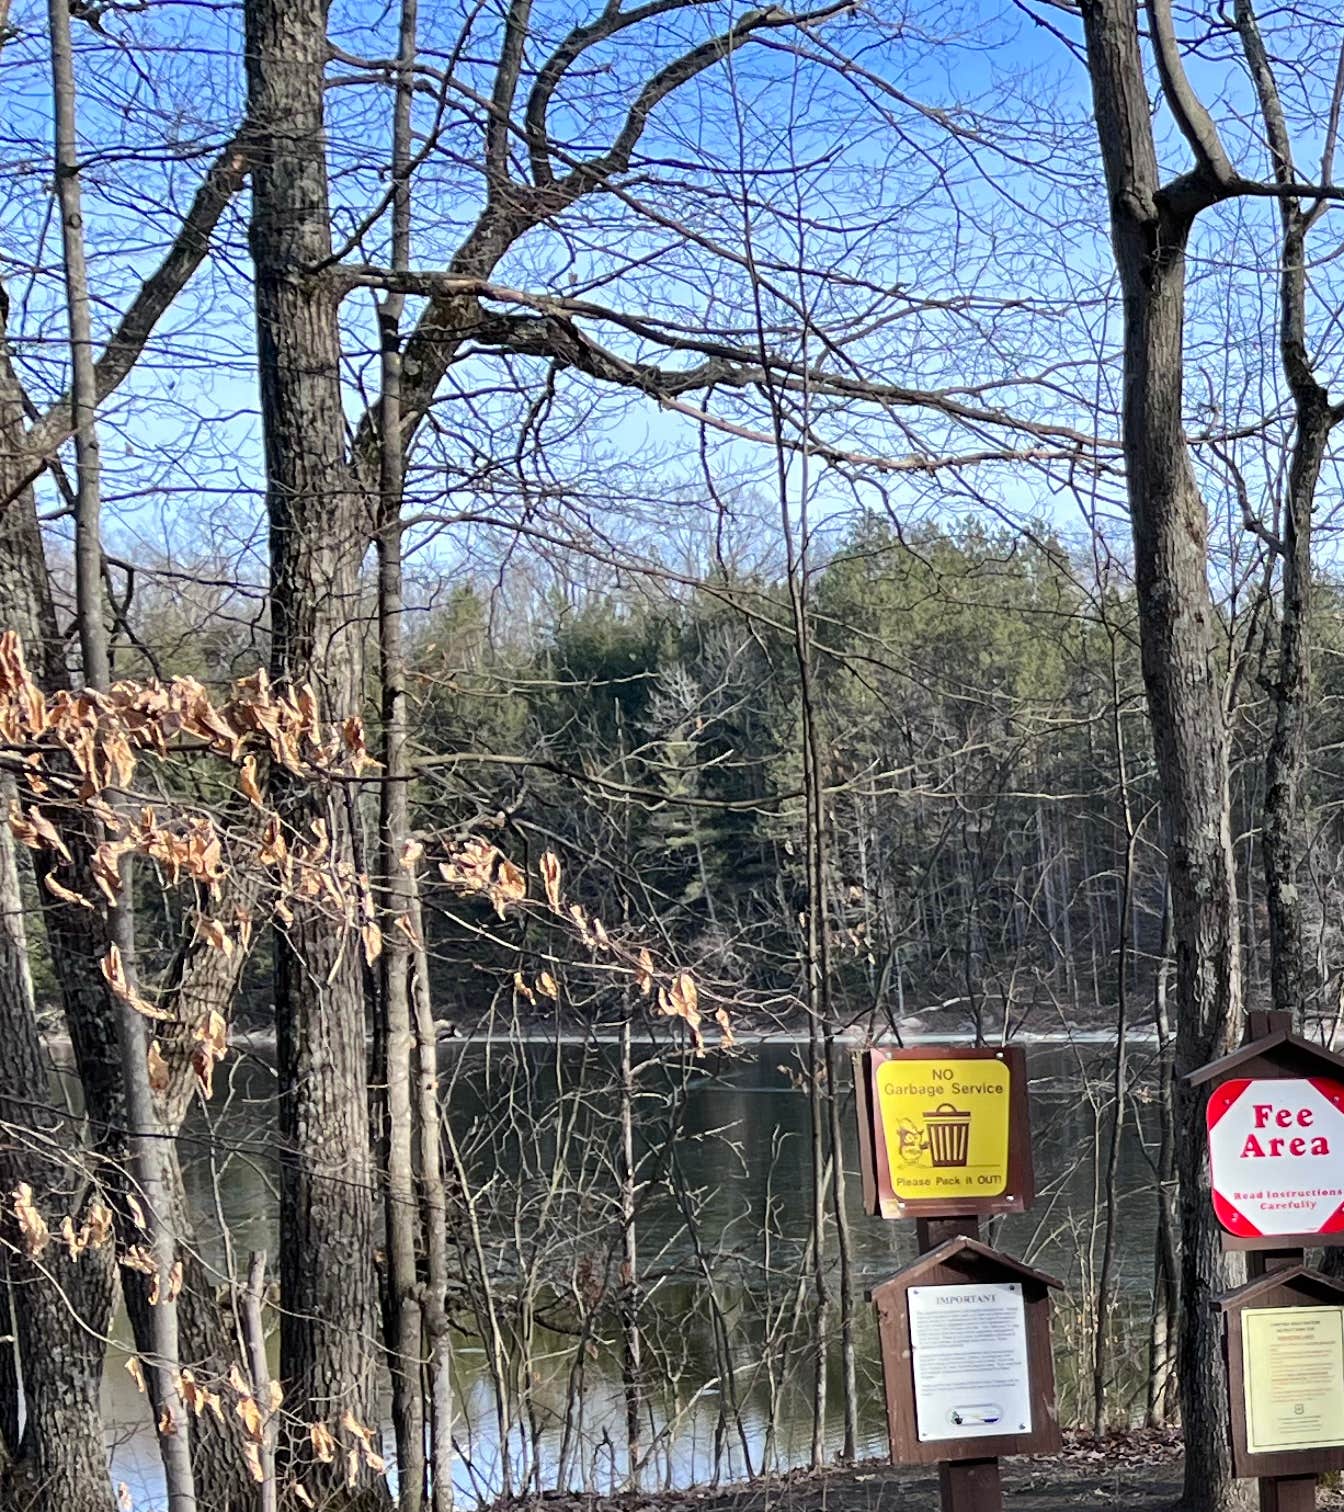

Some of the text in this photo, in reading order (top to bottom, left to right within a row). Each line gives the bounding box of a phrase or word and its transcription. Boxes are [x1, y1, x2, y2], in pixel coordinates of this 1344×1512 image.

[932, 1069, 954, 1081] NO
[884, 1082, 1004, 1097] Garbage Service
[1252, 1104, 1314, 1129] Fee
[1240, 1133, 1331, 1159] Area
[896, 1177, 932, 1187] Please
[936, 1176, 961, 1186] Pack
[1234, 1188, 1343, 1200] Read Instructions
[1260, 1201, 1317, 1211] Carefully
[936, 1294, 997, 1305] IMPORTANT
